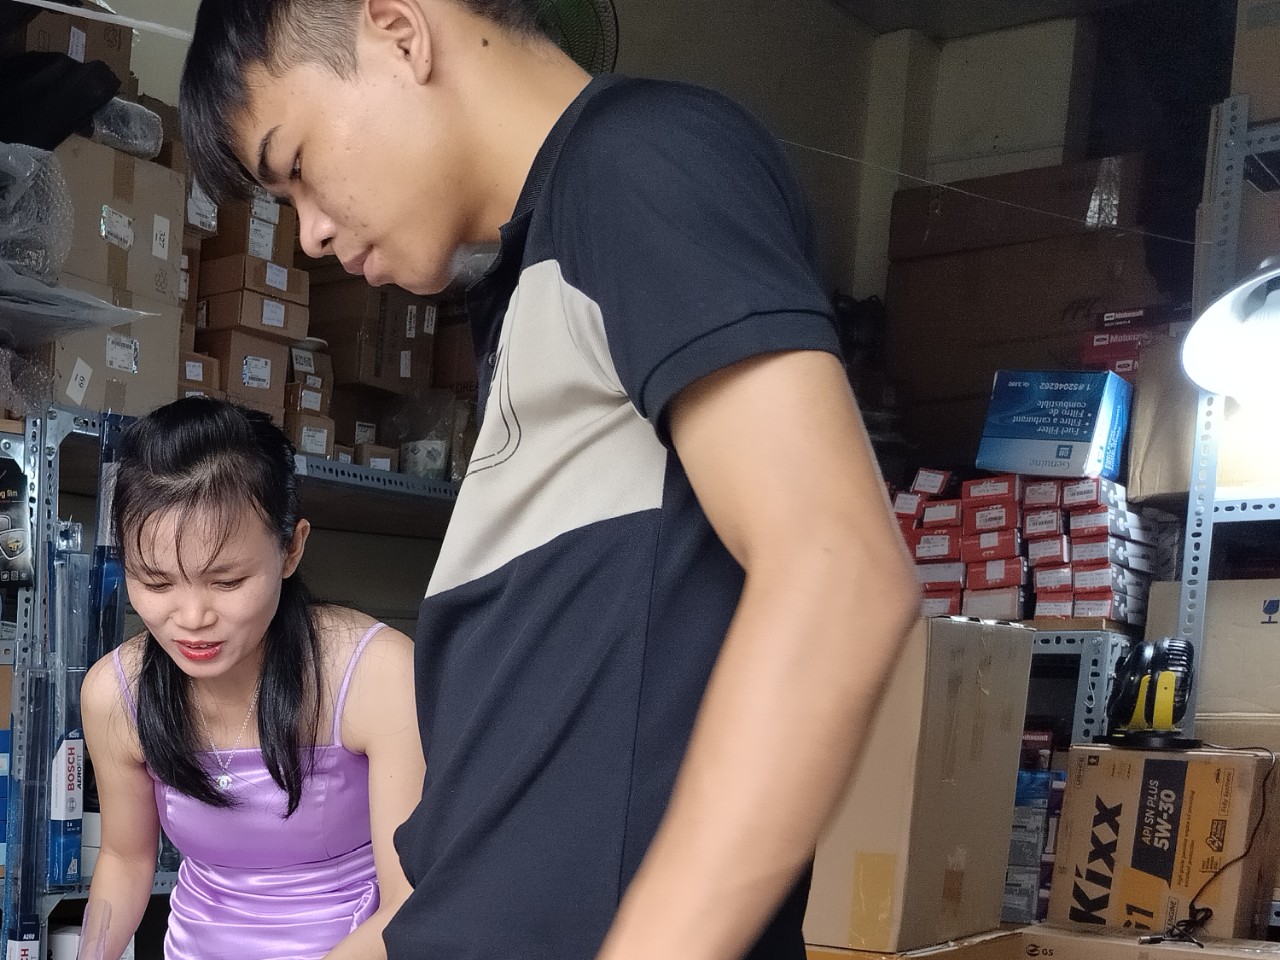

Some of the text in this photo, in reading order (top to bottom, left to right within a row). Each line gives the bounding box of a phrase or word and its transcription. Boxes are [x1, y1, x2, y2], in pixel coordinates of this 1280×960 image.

[1036, 400, 1087, 409] combustible
[1012, 416, 1051, 424] carburant
[1059, 418, 1082, 427] Filtre
[1037, 426, 1080, 435] Fuel Filter
[1029, 459, 1071, 469] Genuine
[67, 747, 76, 791] BOSCH
[1142, 779, 1159, 845] API SN PLUS
[1154, 789, 1177, 851] 5W-30
[1069, 795, 1122, 925] Kixx
[1041, 948, 1053, 957] GS
